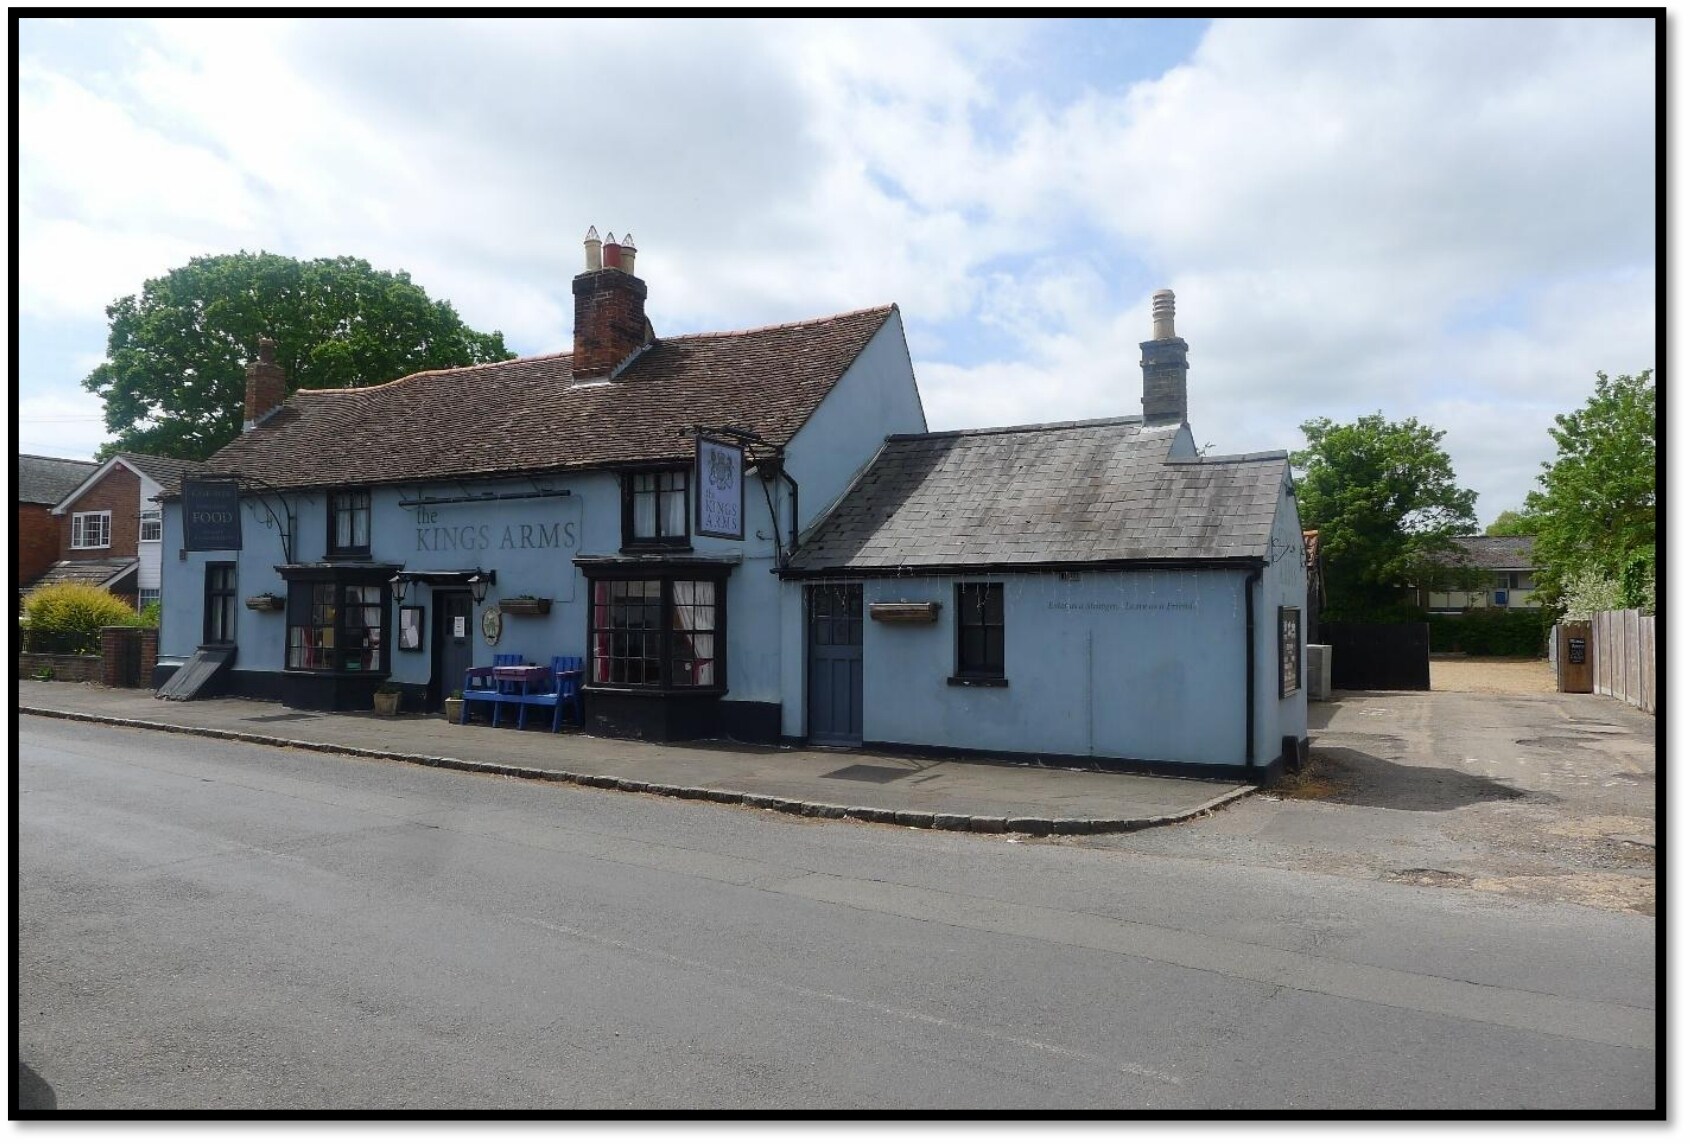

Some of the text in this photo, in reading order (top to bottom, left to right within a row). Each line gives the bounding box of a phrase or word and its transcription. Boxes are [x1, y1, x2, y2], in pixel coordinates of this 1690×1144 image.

[416, 506, 438, 524] the
[705, 500, 737, 517] KINGS
[192, 511, 233, 524] FOOD
[705, 513, 737, 529] ARMS
[416, 522, 576, 551] KINGS ARMS
